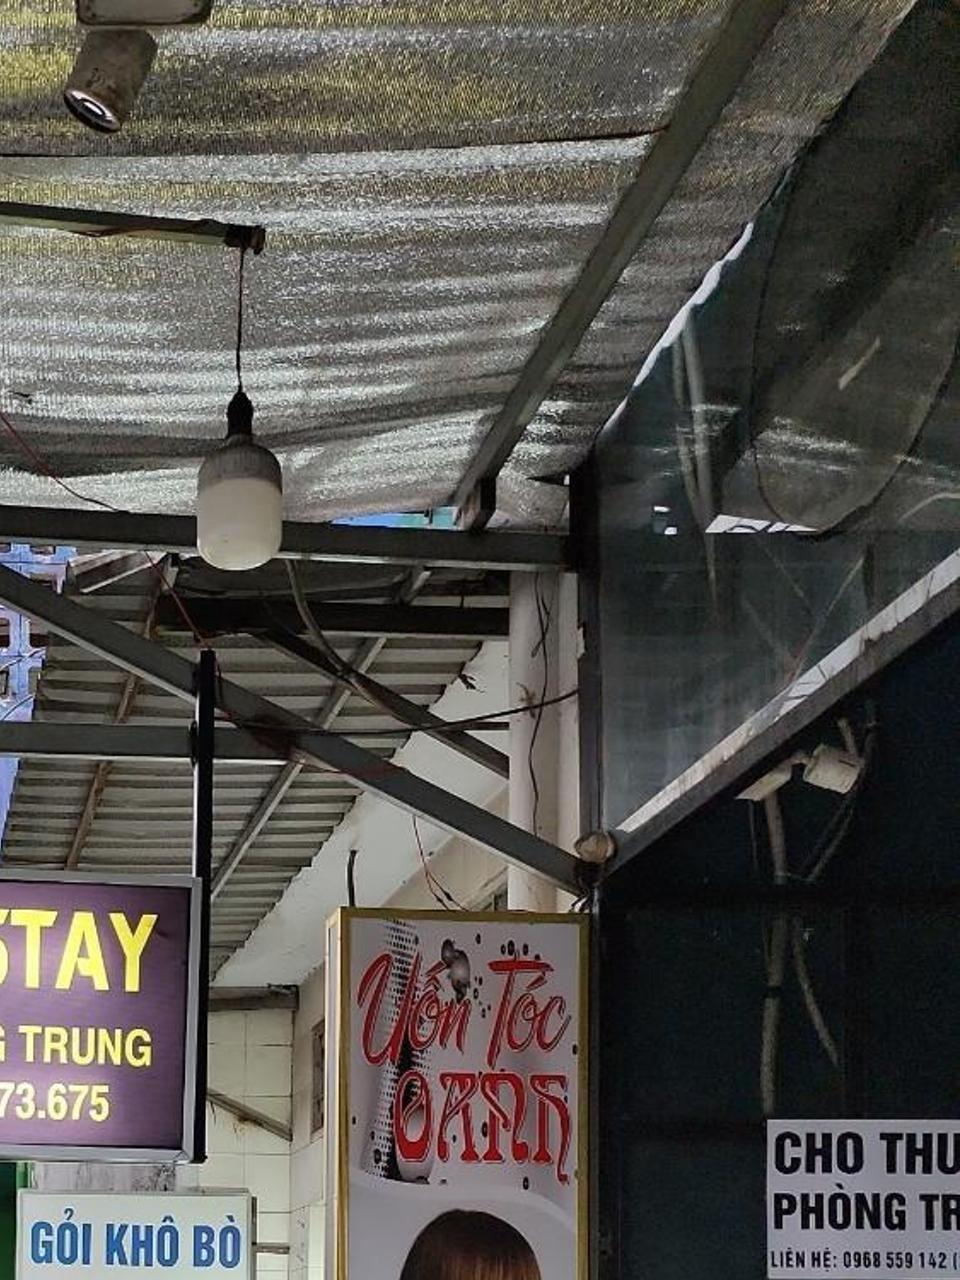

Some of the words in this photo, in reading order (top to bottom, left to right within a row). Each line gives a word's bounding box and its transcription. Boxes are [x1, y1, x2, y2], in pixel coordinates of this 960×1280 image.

[488, 958, 572, 1070] Tóc
[18, 1024, 152, 1067] TRUNG
[774, 1131, 864, 1175] CHO
[773, 1183, 907, 1231] PHÒNG
[30, 1207, 93, 1265] GỎI
[105, 1214, 180, 1267] KHÔ
[192, 1214, 242, 1269] BÒ
[771, 1247, 806, 1268] LIÊN
[843, 1251, 881, 1269] 0968
[886, 1251, 913, 1269] 559
[919, 1251, 947, 1269] 142
